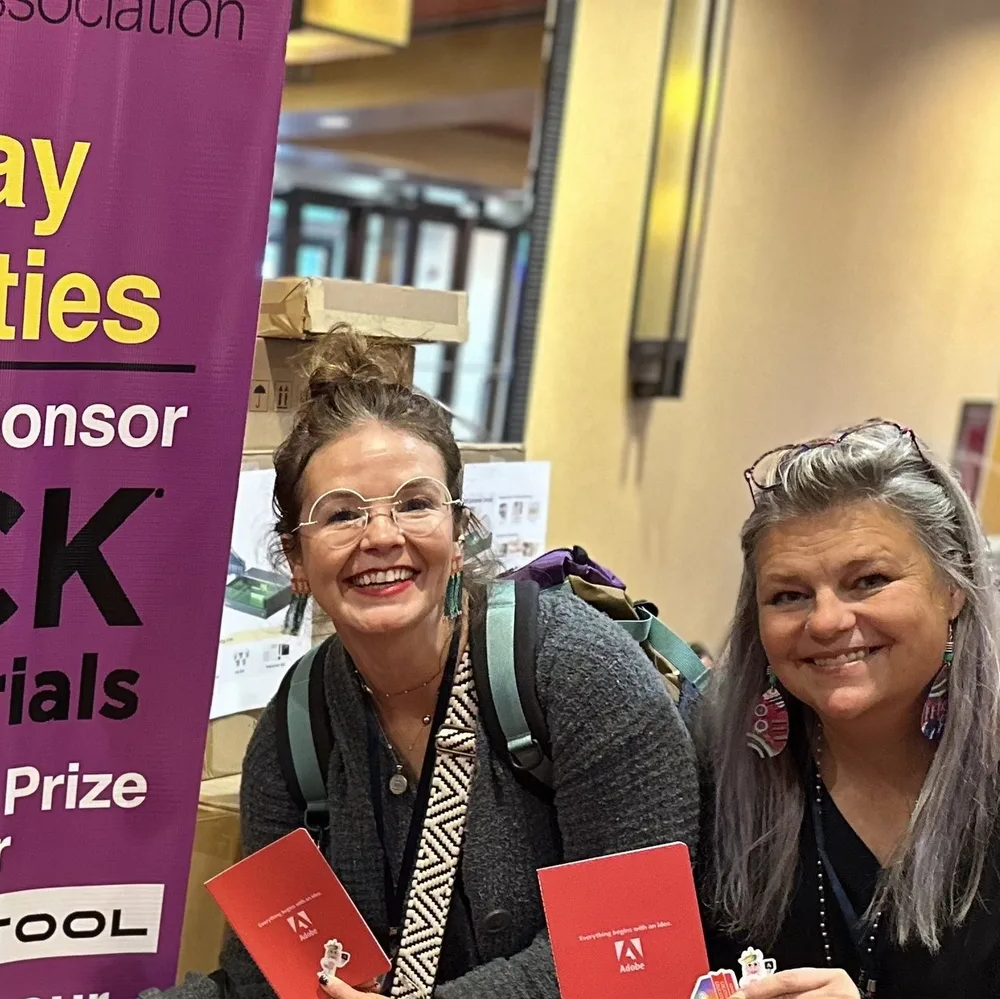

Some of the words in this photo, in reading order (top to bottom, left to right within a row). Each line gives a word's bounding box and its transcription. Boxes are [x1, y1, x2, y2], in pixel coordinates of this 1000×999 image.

[4, 762, 148, 817] Prize
[299, 928, 318, 941] Adobe
[578, 931, 612, 942] Everything
[612, 927, 633, 936] begins
[633, 924, 648, 932] with
[619, 962, 646, 974] Adobe
